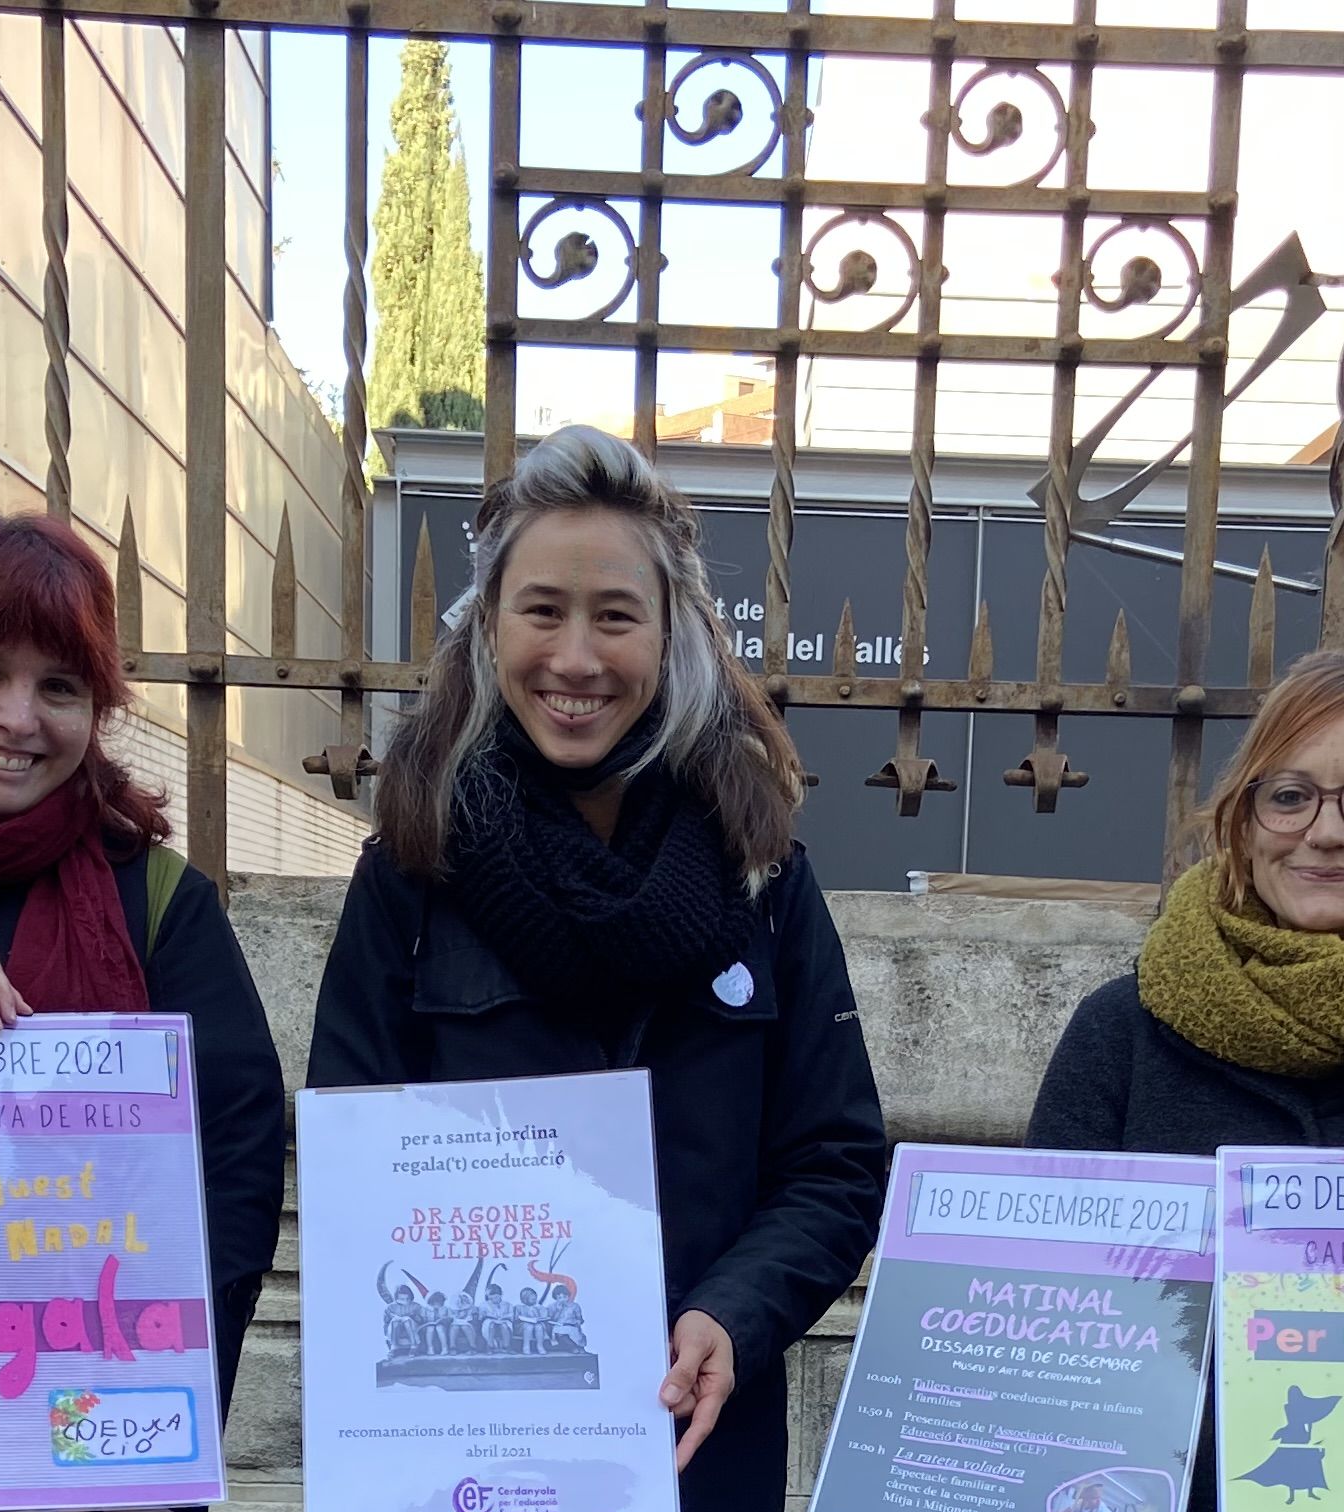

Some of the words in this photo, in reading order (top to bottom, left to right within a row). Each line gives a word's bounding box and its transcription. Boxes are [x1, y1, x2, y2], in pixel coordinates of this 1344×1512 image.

[734, 599, 764, 621] de
[836, 634, 929, 666] all
[55, 1041, 126, 1075] 2021
[40, 1104, 71, 1128] DE
[85, 1104, 142, 1128] REIS
[401, 1135, 429, 1151] per
[433, 1135, 443, 1145] a
[447, 1131, 492, 1145] santa
[495, 1124, 558, 1147] jordina
[392, 1156, 467, 1176] regala('t)
[471, 1150, 565, 1169] coeducació
[1265, 1175, 1302, 1210] 26
[412, 1203, 550, 1225] DRAGONES
[928, 1188, 953, 1219] 18
[960, 1190, 991, 1221] DE
[996, 1192, 1125, 1229] DESEMBRE
[1129, 1199, 1190, 1232] 2021
[391, 1225, 442, 1244] QUE
[451, 1221, 572, 1242] DEVOREN
[432, 1240, 541, 1259] LLIBRES
[967, 1277, 1123, 1317] MATINAL
[920, 1306, 1161, 1354] COEDUCATIVA
[1247, 1318, 1326, 1354] Per
[920, 1336, 1005, 1360] DISSABTE
[1010, 1346, 1026, 1362] 18
[1031, 1350, 1053, 1365] DE
[1058, 1353, 1143, 1373] DESEMBRE
[952, 1360, 985, 1373] MUSEU
[1021, 1369, 1034, 1378] DE
[1037, 1370, 1102, 1385] CERDANYOLA
[912, 1377, 950, 1392] Tallers
[953, 1383, 998, 1399] creatius
[1001, 1391, 1068, 1408] coeducatius
[1070, 1400, 1089, 1411] per
[1093, 1403, 1100, 1411] a
[1103, 1401, 1143, 1415] infants
[915, 1391, 961, 1408] famílies
[339, 1424, 444, 1439] recomanacions
[447, 1424, 464, 1437] de
[467, 1424, 486, 1437] les
[489, 1423, 550, 1437] llibreries
[553, 1423, 570, 1436] de
[573, 1422, 647, 1440] cerdanyola
[885, 1407, 893, 1418] h
[904, 1411, 969, 1430] Presentació
[971, 1421, 985, 1433] de
[1056, 1433, 1123, 1451] Cerdanyola
[900, 1425, 952, 1442] Educació
[955, 1433, 1010, 1451] Feminista
[466, 1445, 498, 1458] abril
[502, 1447, 532, 1459] 2021
[878, 1444, 886, 1455] h
[895, 1447, 913, 1461] La
[916, 1454, 959, 1469] rateta
[964, 1458, 1026, 1479] voladora
[497, 1486, 556, 1497] Cerdanyola
[890, 1465, 948, 1484] Espectacle
[950, 1476, 996, 1492] familiar
[498, 1499, 511, 1508] per
[882, 1492, 912, 1508] Mitja
[886, 1478, 921, 1494] càrrec
[923, 1485, 937, 1497] de
[940, 1488, 950, 1499] la
[954, 1491, 1016, 1511] companyia
